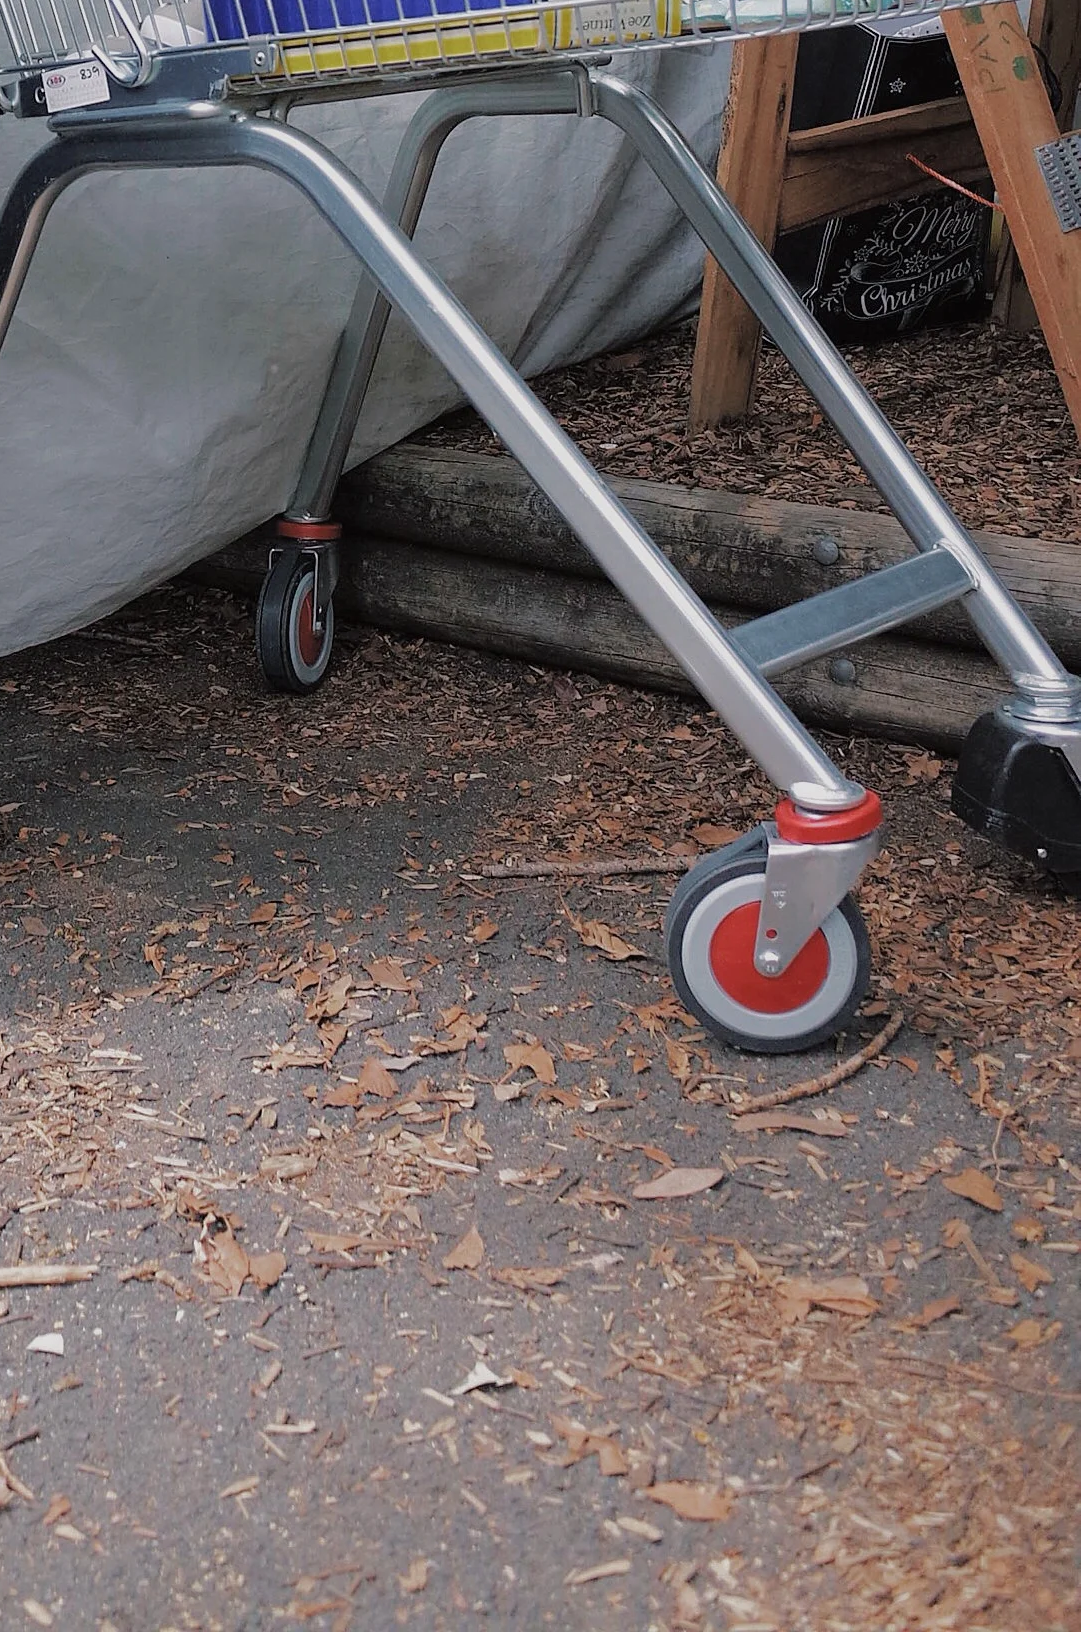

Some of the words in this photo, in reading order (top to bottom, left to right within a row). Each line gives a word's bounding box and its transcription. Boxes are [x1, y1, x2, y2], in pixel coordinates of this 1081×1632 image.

[628, 15, 652, 28] Zoe
[79, 66, 100, 80] 839
[893, 206, 977, 246] Merry
[860, 257, 972, 317] Christmas
